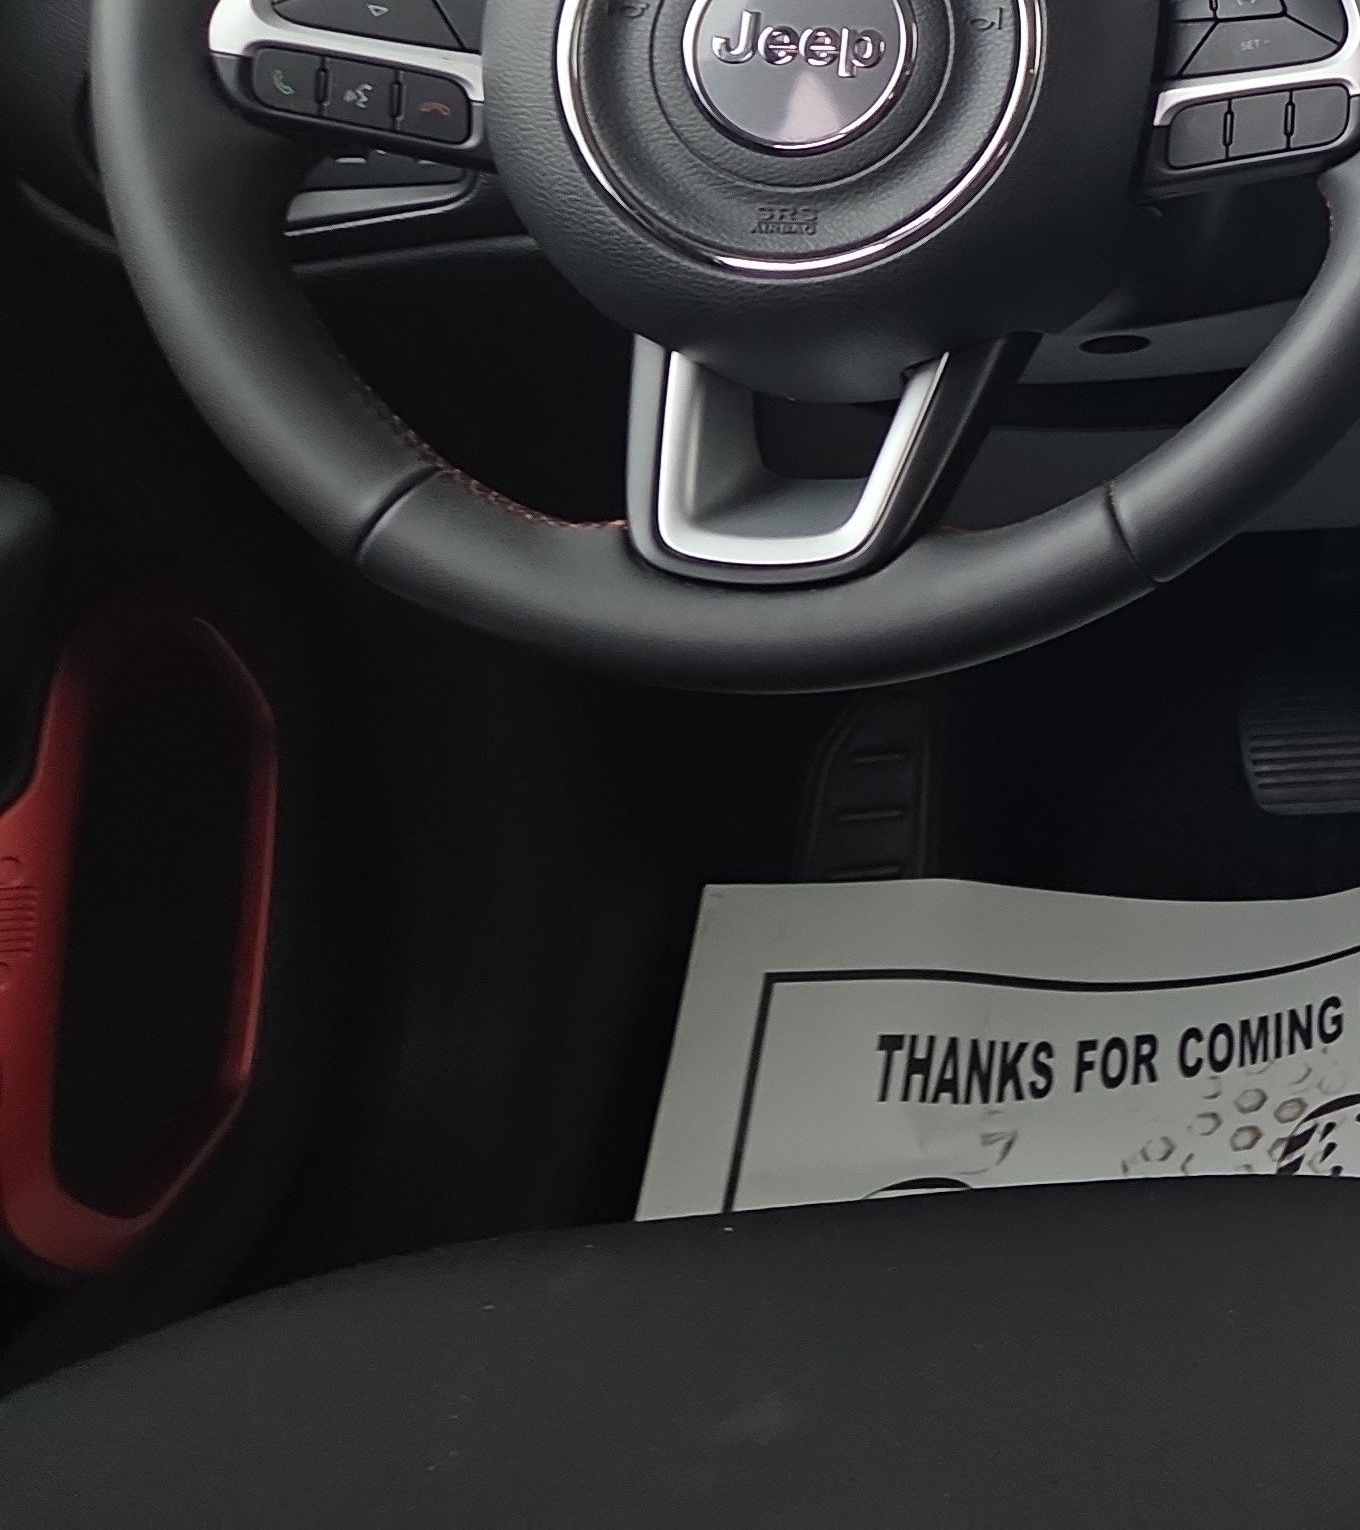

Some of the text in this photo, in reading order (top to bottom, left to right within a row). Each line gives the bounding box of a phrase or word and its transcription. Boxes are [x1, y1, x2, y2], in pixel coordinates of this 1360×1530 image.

[711, 9, 887, 79] Jeep
[876, 1033, 1055, 1105] THANKS
[1074, 1032, 1160, 1093] FOR
[1178, 995, 1344, 1079] COMING
